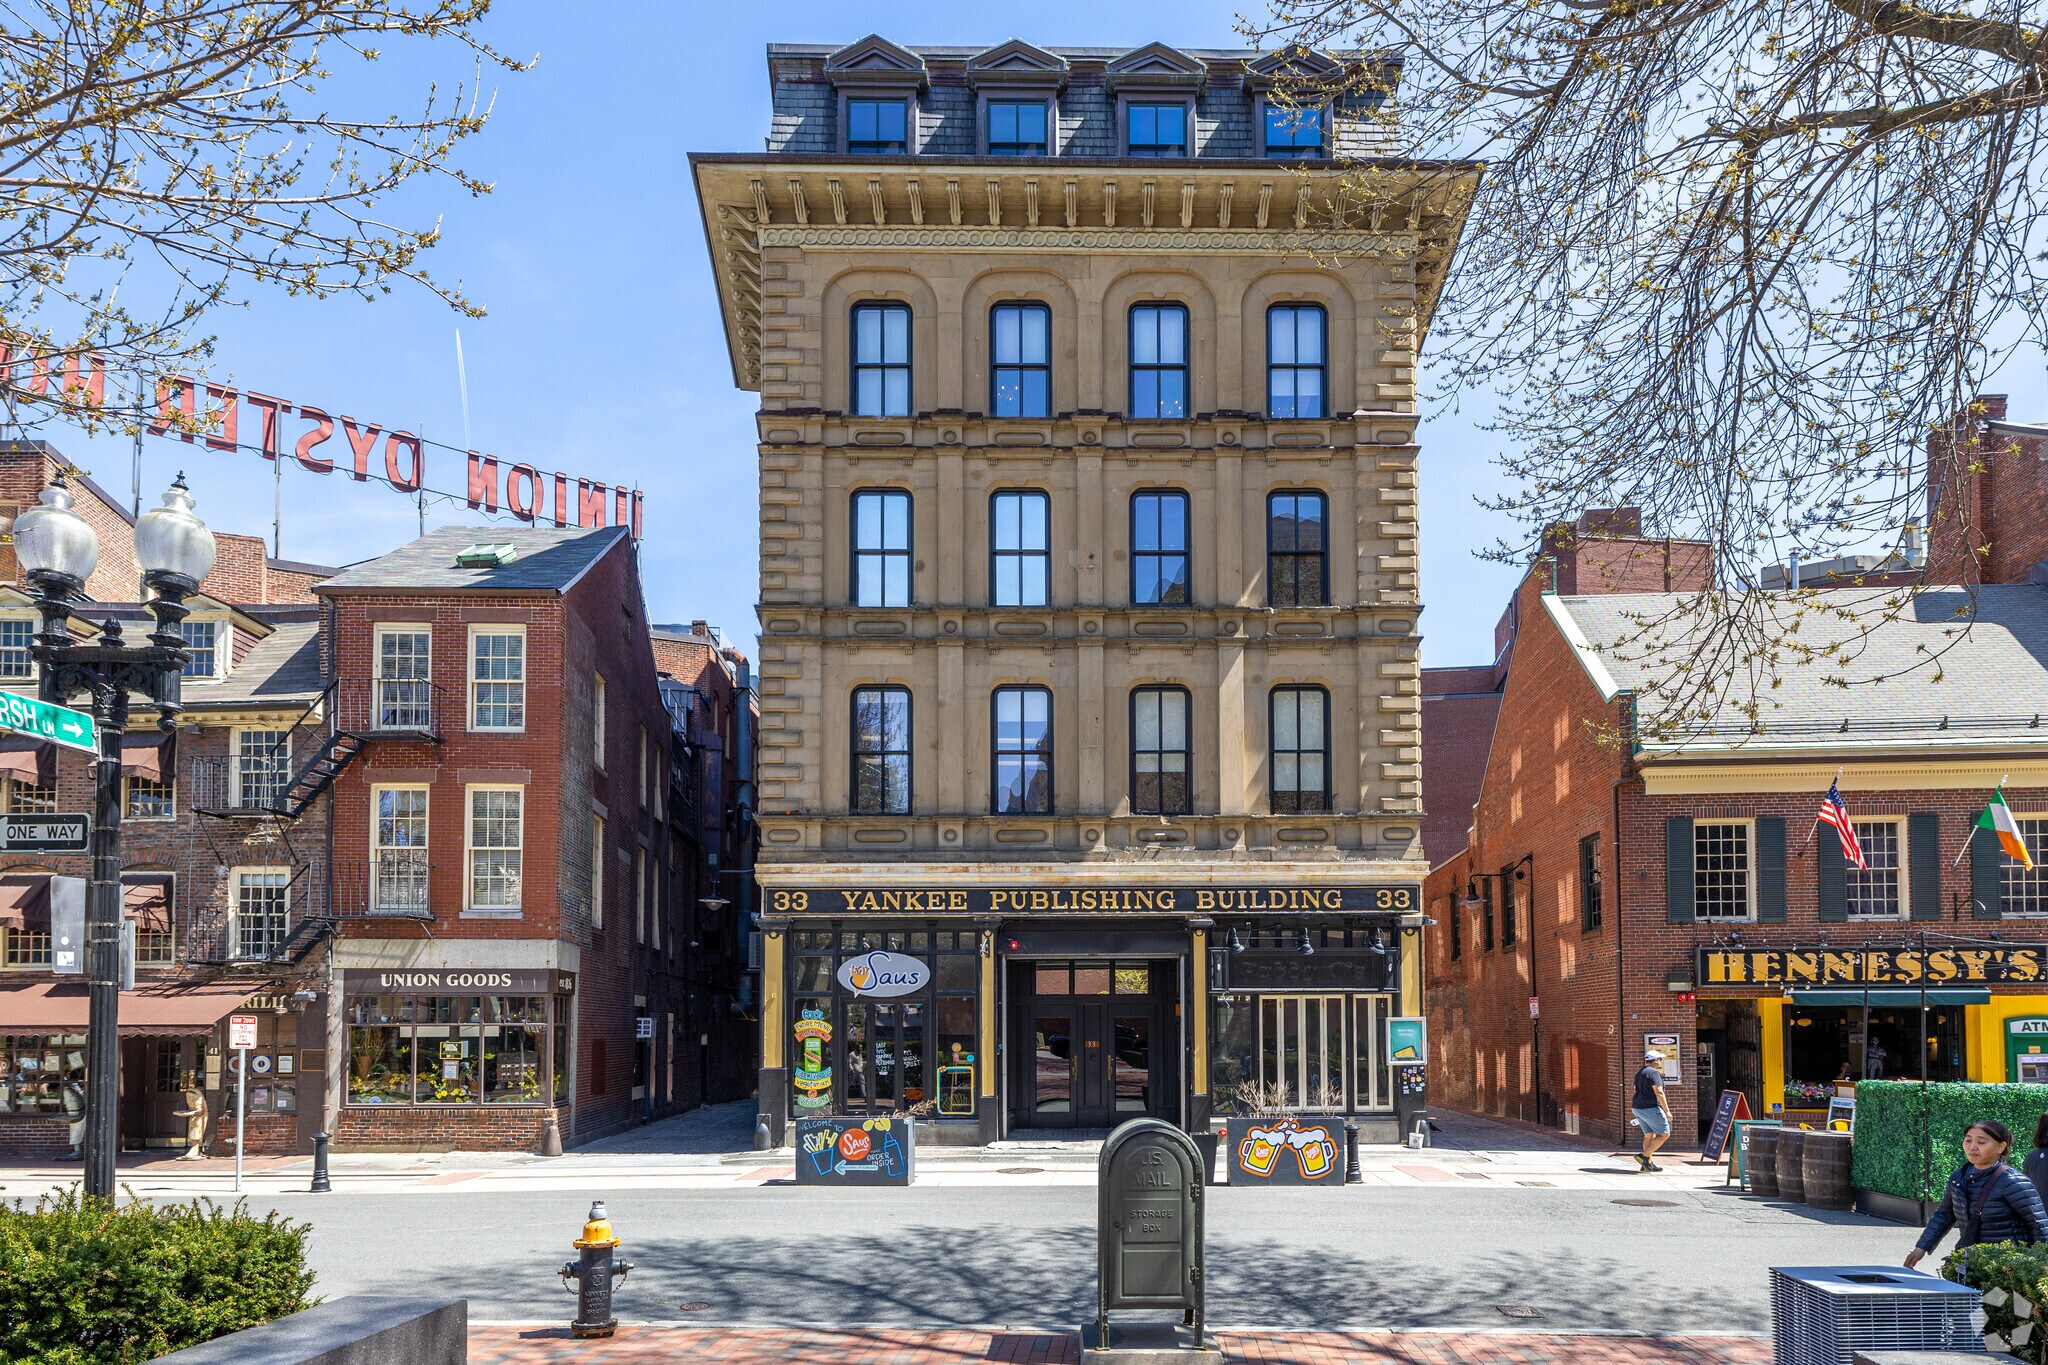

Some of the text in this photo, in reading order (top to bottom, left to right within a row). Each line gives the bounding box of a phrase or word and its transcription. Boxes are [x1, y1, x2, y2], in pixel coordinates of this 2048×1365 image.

[42, 719, 55, 735] LN
[6, 825, 78, 839] ONE WAY
[773, 889, 1411, 911] 33 YANKEE PUBLISHING BUILDING 33
[850, 951, 920, 991] Saus
[1707, 949, 2038, 983] HENNESSY'S
[380, 973, 512, 987] UNION GOODS
[1087, 1040, 1096, 1048] 33
[208, 1047, 218, 1055] 41
[799, 1119, 844, 1132] WELCOME TO
[867, 1152, 890, 1161] ORDER
[871, 1158, 895, 1167] INSIDE
[1133, 1171, 1171, 1187] MAIL
[1130, 1209, 1174, 1219] STORAGE
[1142, 1223, 1161, 1233] BOX
